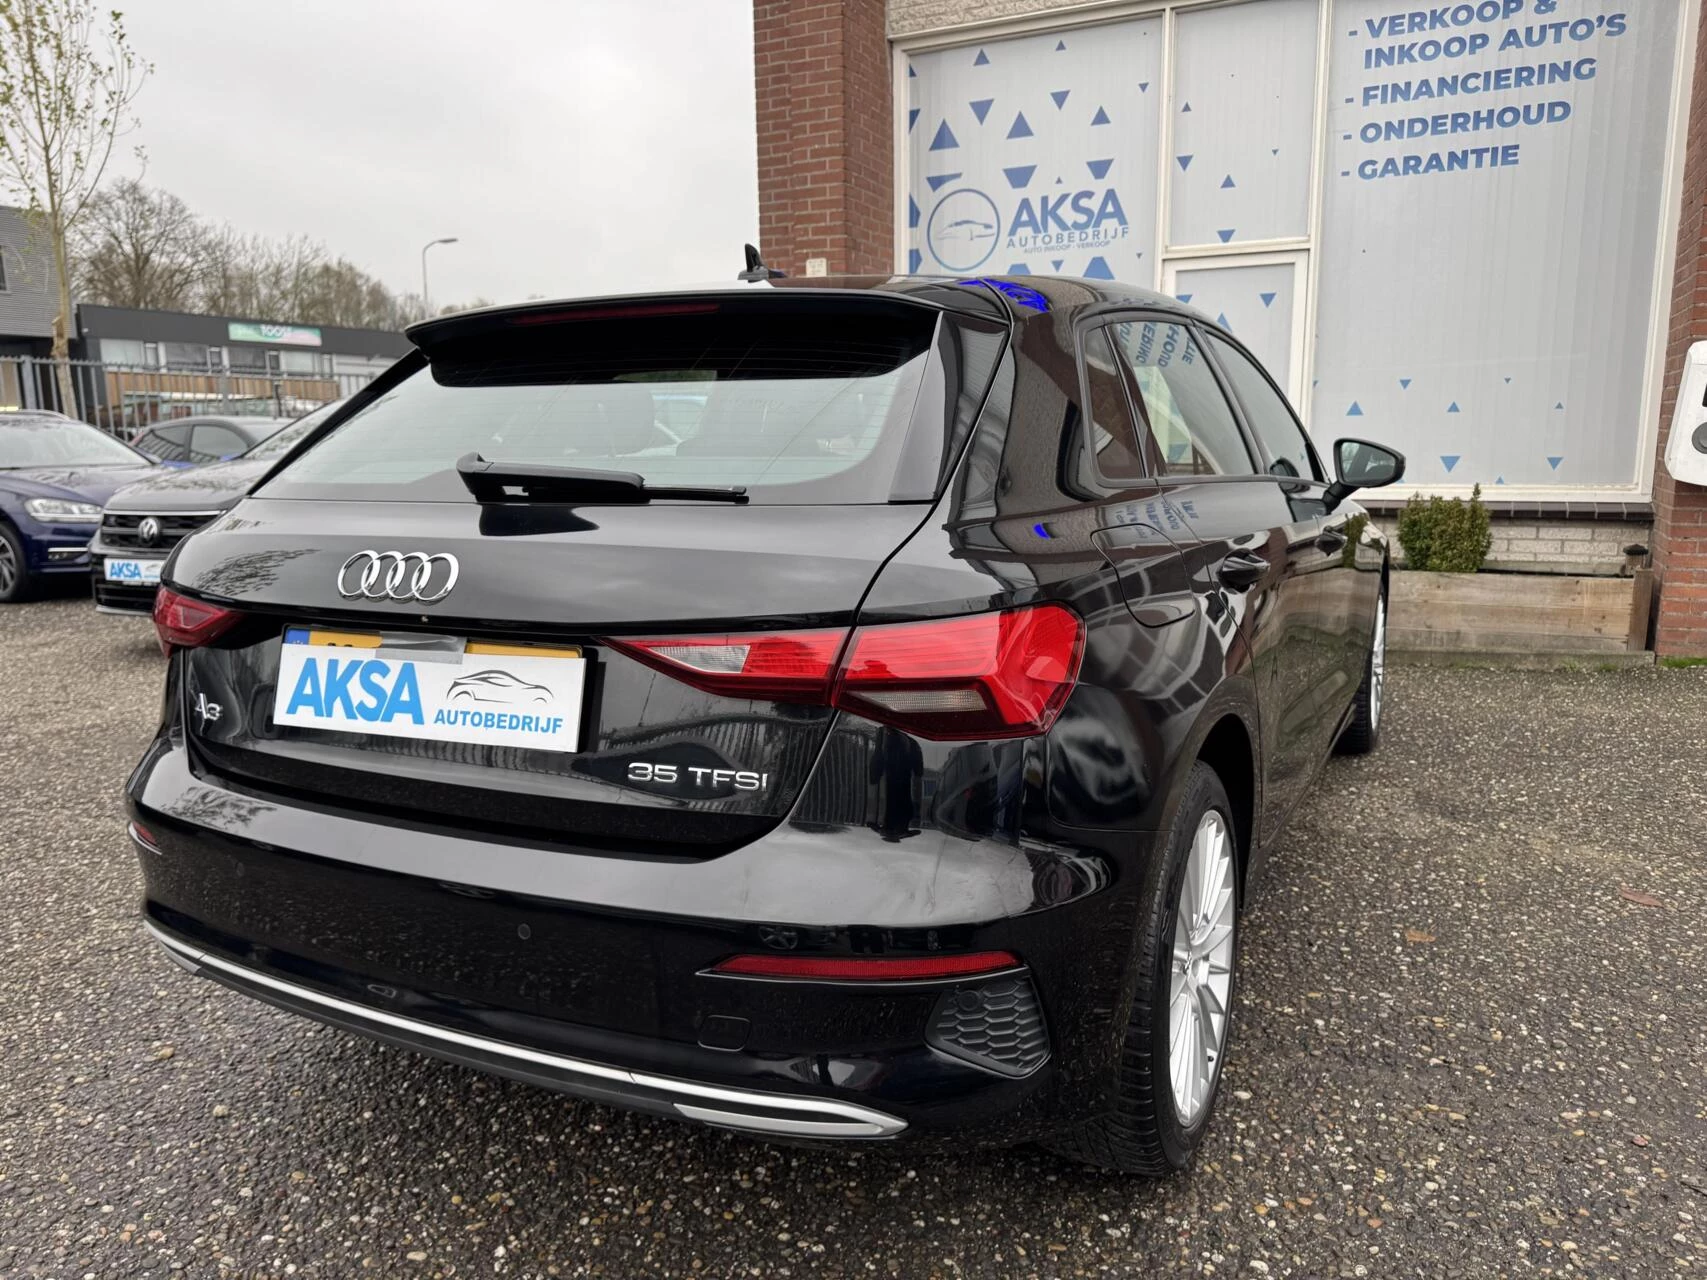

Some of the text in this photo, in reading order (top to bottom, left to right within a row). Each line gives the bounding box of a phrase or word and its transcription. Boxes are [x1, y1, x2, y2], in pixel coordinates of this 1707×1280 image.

[1365, 0, 1524, 39] VERKOOP
[1364, 13, 1627, 69] INKOOP AUTO'S
[1362, 58, 1596, 107] FINANCIERING
[1359, 100, 1571, 144] ONDERHOUD
[1357, 144, 1520, 180] GARANTIE
[1007, 188, 1129, 237] AKSA
[1006, 227, 1129, 249] AUTOBEDRIJF
[1076, 240, 1111, 249] VERKOOP
[110, 561, 142, 579] AKSA
[194, 692, 221, 721] A3
[286, 657, 425, 725] AKSA
[433, 708, 563, 734] AUTOBEDRIJF
[627, 761, 769, 792] 35 TFSI
